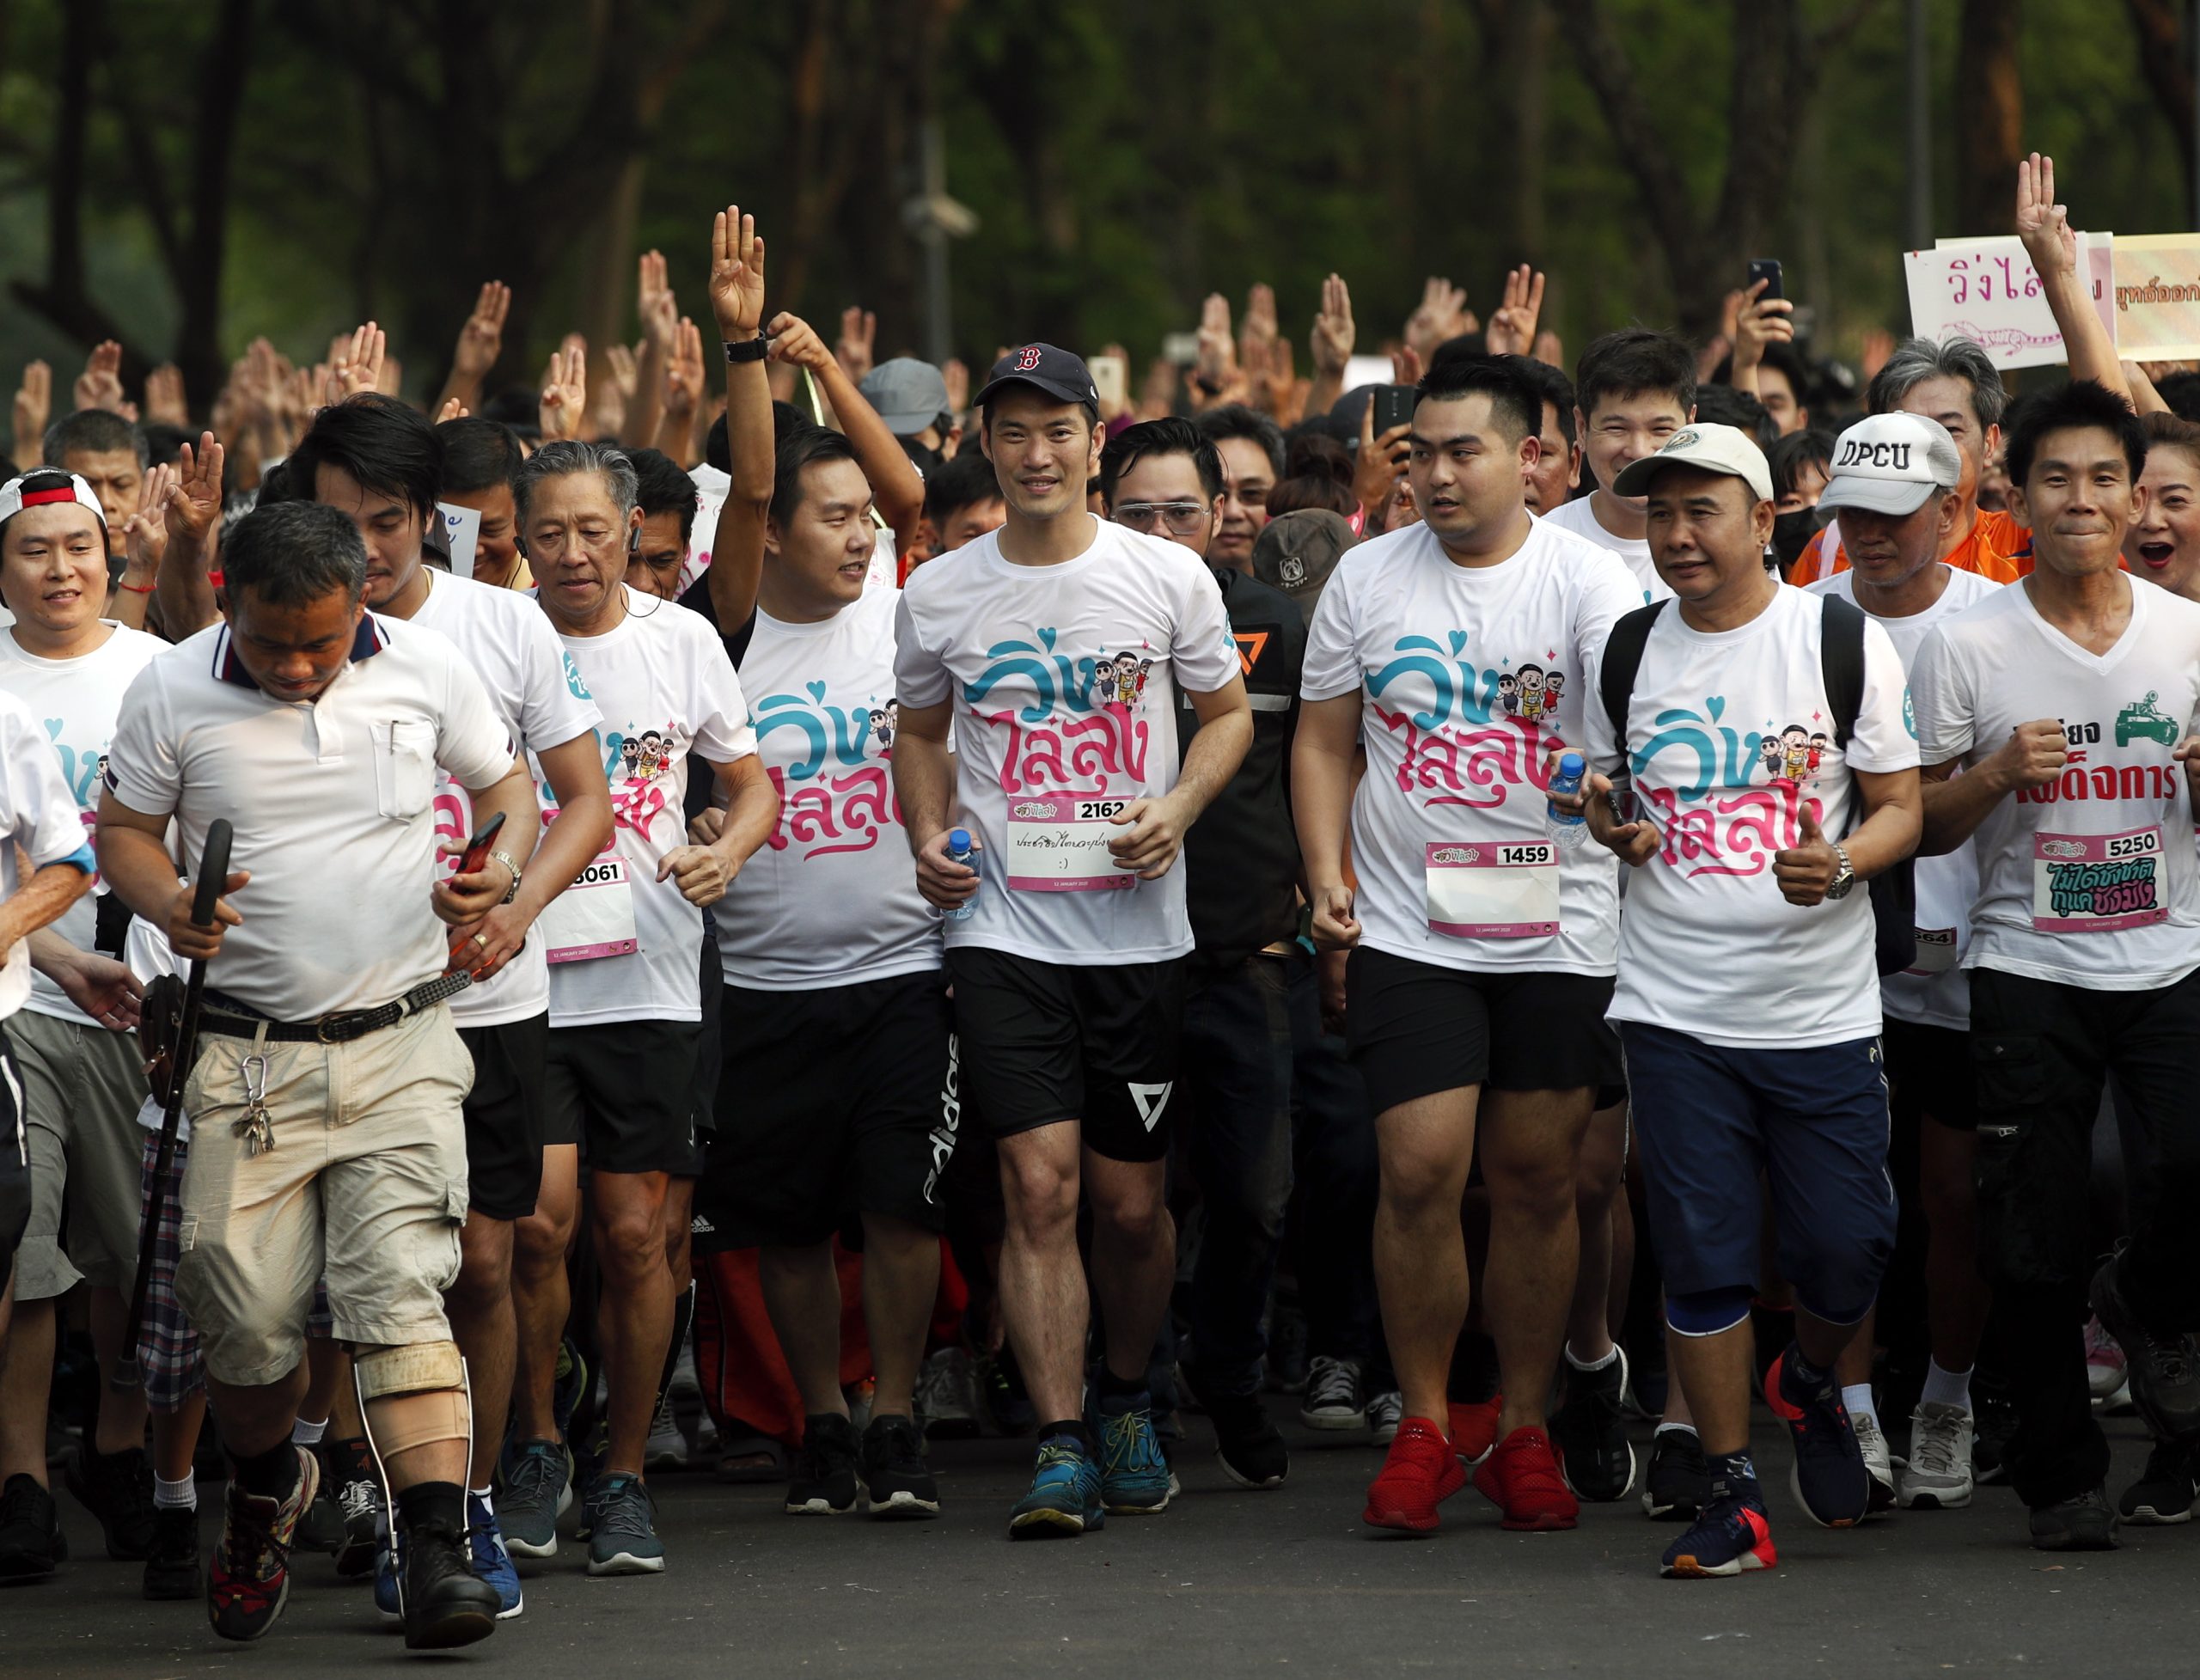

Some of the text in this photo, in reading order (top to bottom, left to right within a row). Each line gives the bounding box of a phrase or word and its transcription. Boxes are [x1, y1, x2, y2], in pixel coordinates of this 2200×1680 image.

[1014, 345, 1042, 371] B
[1837, 440, 1911, 471] DPCU
[971, 700, 1149, 797] ไล่ลุง
[766, 767, 906, 863] ไล่ลุ
[1081, 802, 1125, 819] 2162
[1503, 846, 1549, 864] 1459
[2110, 834, 2155, 857] 5250
[923, 1032, 961, 1205] adidas
